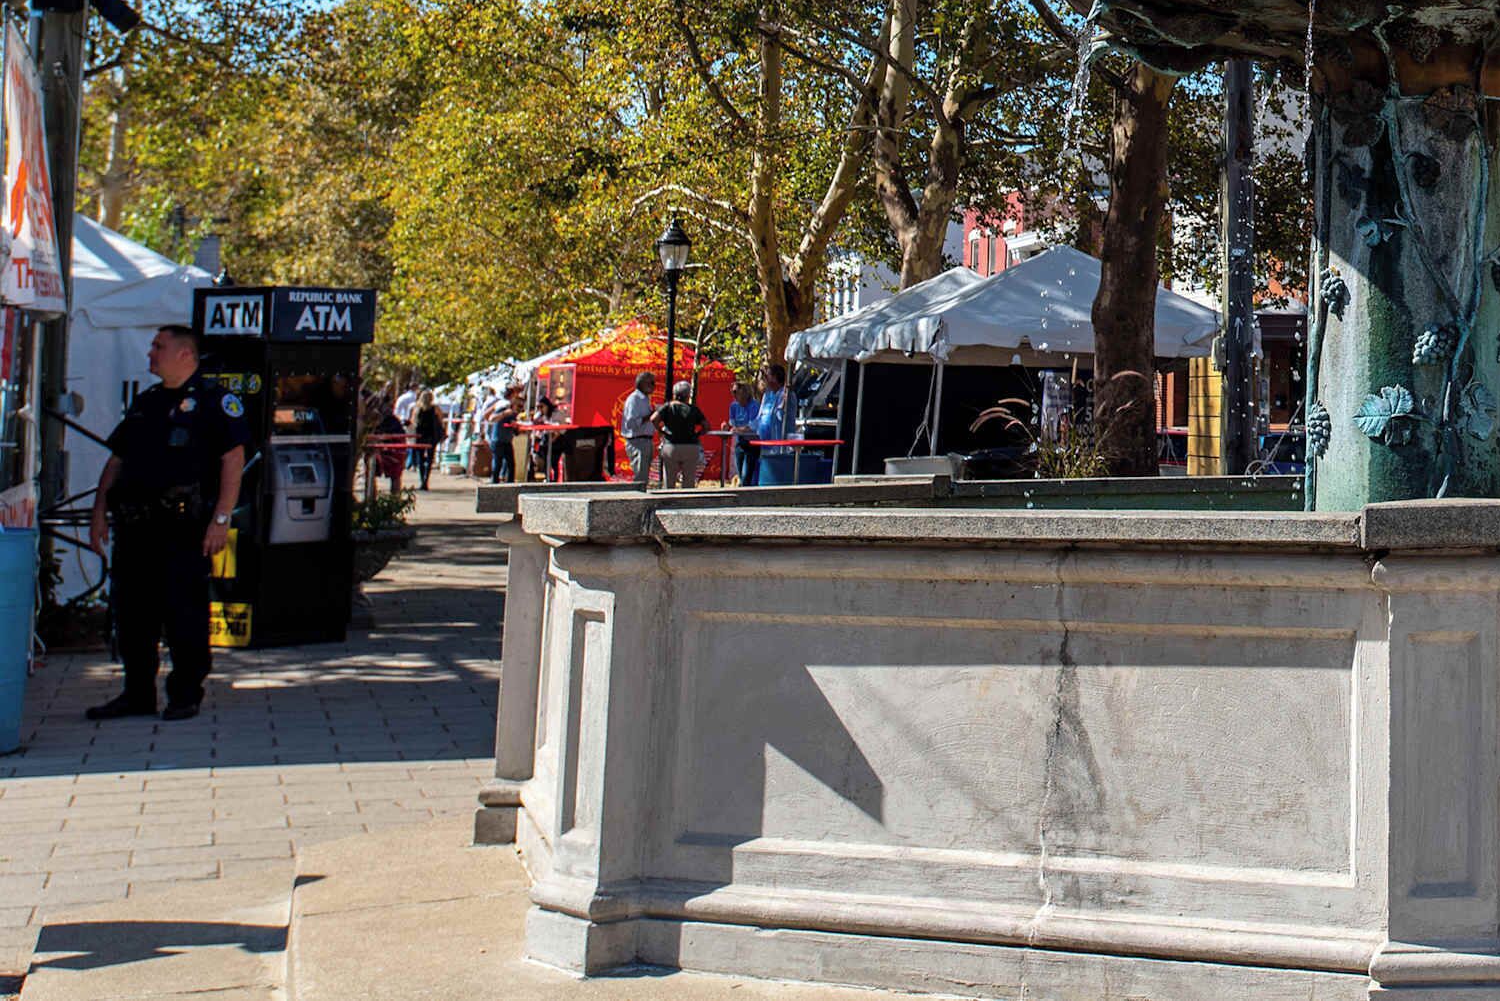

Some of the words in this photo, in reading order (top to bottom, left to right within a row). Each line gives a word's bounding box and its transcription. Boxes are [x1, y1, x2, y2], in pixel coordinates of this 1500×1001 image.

[288, 292, 334, 303] REPUBLIC
[336, 293, 363, 303] BANK
[210, 302, 260, 328] ATM
[295, 305, 352, 332] ATM
[576, 365, 621, 376] entucky
